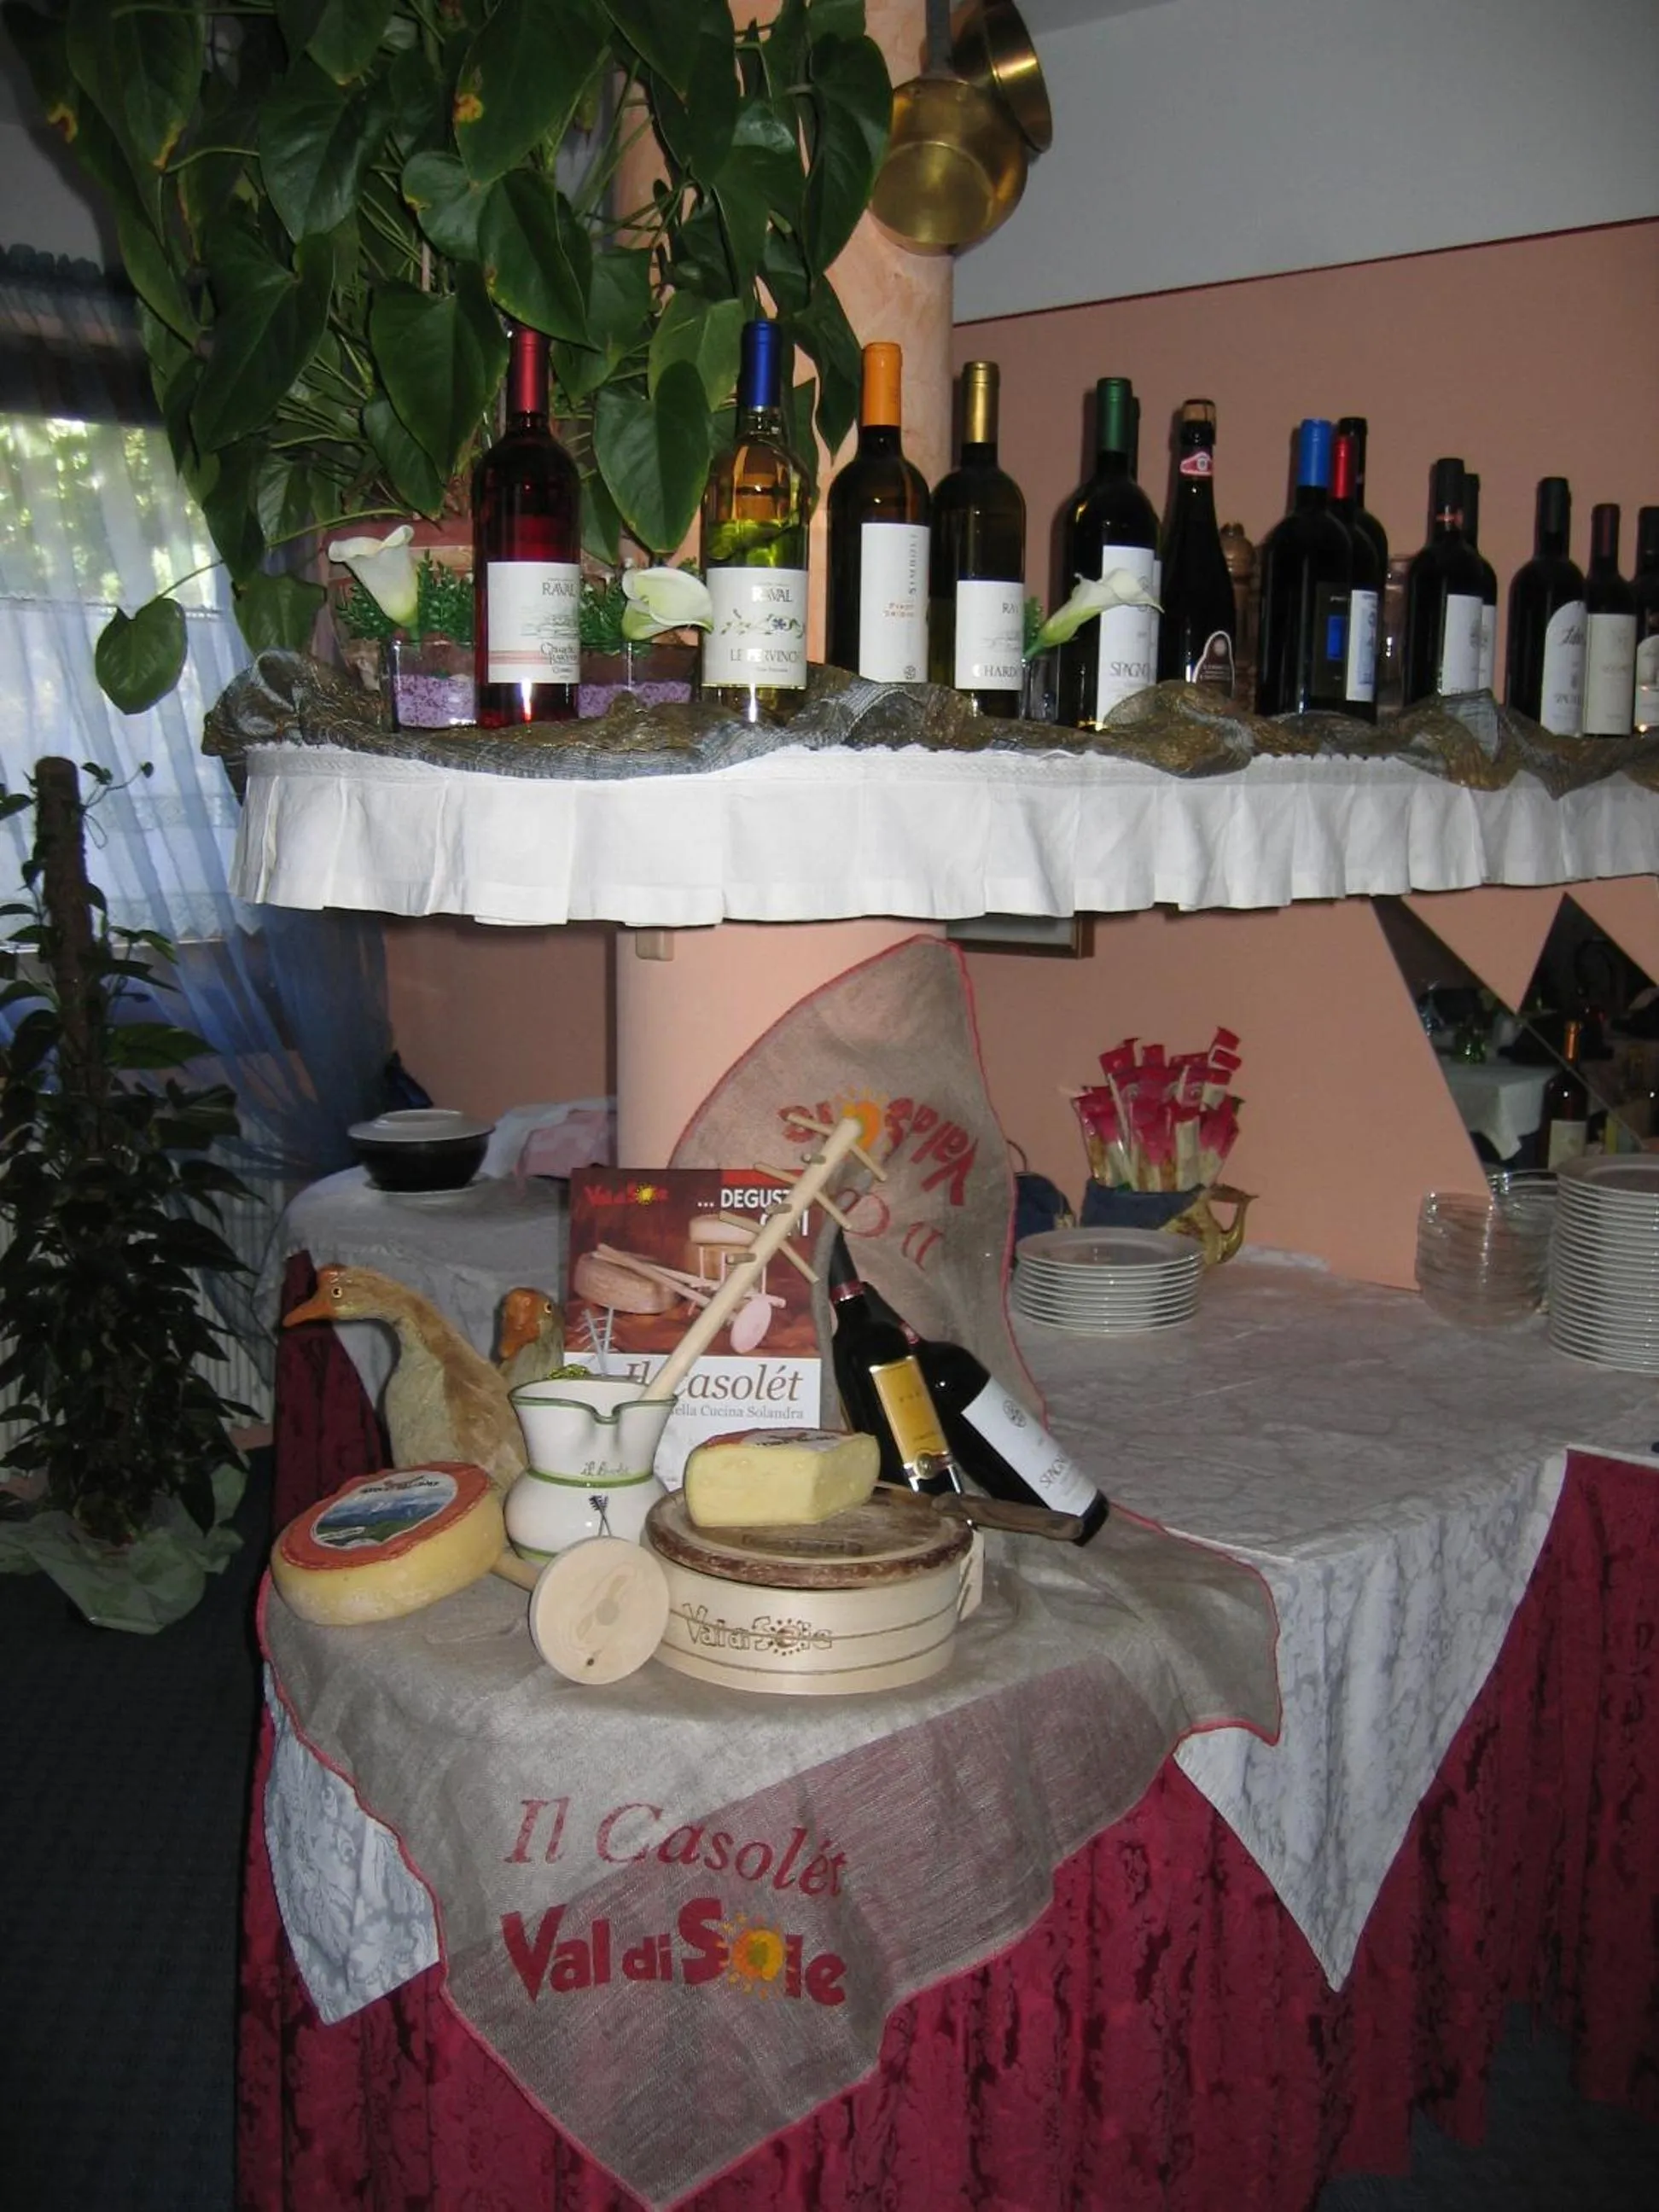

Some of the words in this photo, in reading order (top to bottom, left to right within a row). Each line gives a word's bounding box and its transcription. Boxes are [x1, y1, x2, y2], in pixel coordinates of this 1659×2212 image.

[681, 1364, 803, 1401] asolét
[700, 1406, 744, 1417] Cucina
[746, 1406, 804, 1420] Solandra
[503, 1796, 571, 1865] Il
[597, 1802, 850, 1898] Casolét
[500, 1903, 612, 2004] Val
[621, 1933, 674, 1982] di
[677, 1896, 847, 2007] Sole
